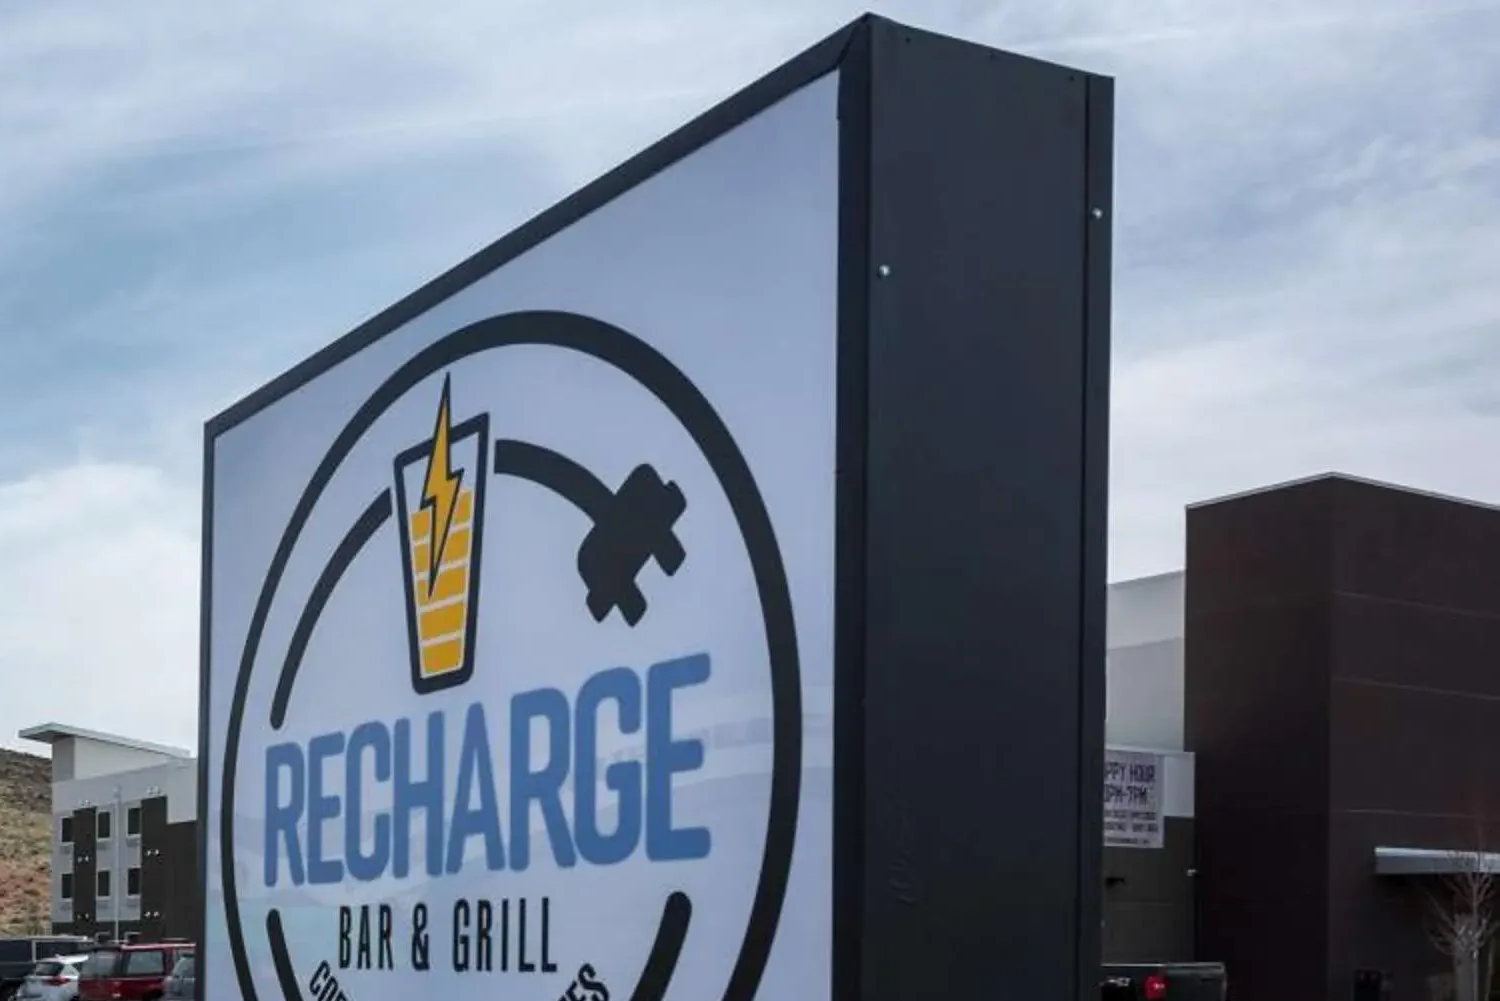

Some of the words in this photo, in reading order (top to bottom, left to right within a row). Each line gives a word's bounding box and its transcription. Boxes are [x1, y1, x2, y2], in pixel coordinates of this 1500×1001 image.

[264, 652, 712, 888] RECHARGE
[1104, 762, 1127, 781] PPY
[1130, 763, 1157, 782] HOUR
[338, 904, 394, 970] BAR
[411, 902, 430, 972] &
[452, 897, 558, 973] GRILL
